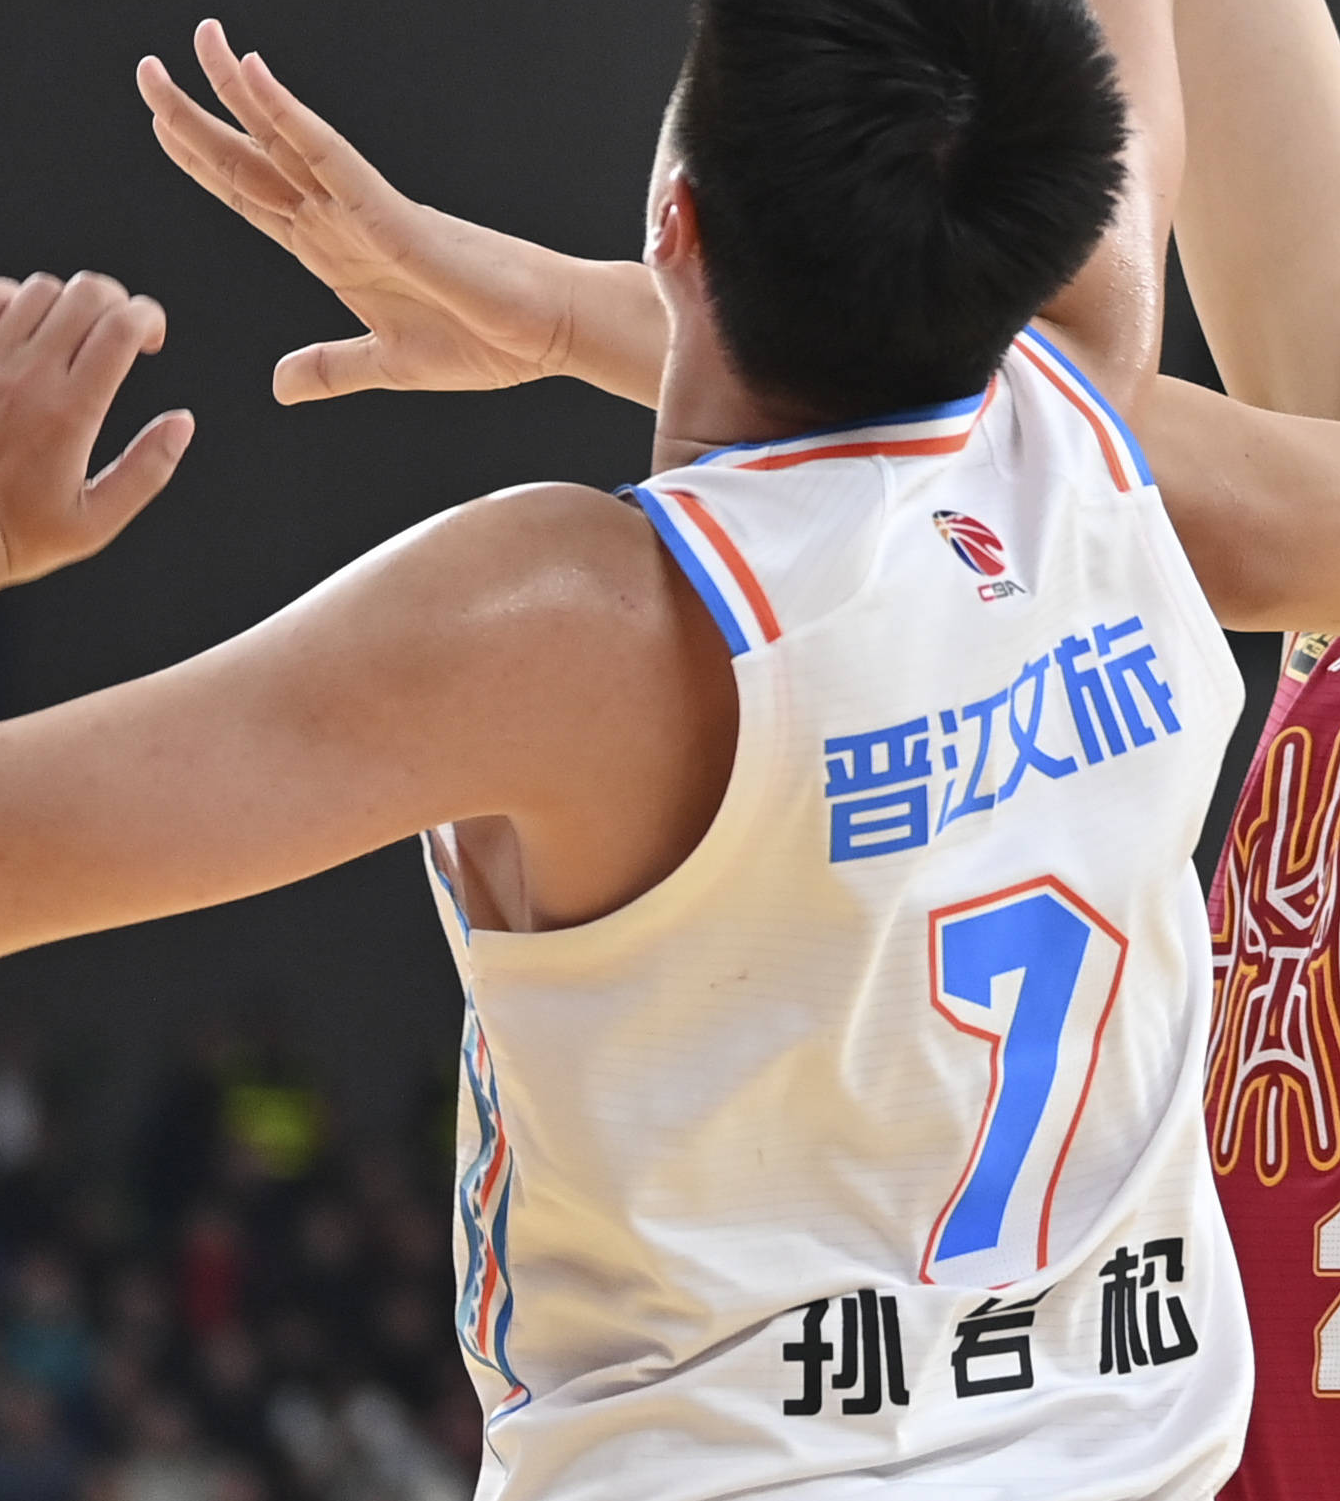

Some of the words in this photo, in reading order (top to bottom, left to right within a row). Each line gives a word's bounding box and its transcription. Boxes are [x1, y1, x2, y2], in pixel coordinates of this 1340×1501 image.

[977, 580, 1026, 602] CBA
[825, 617, 1183, 863] 晋江文旅
[919, 875, 1128, 1290] 7
